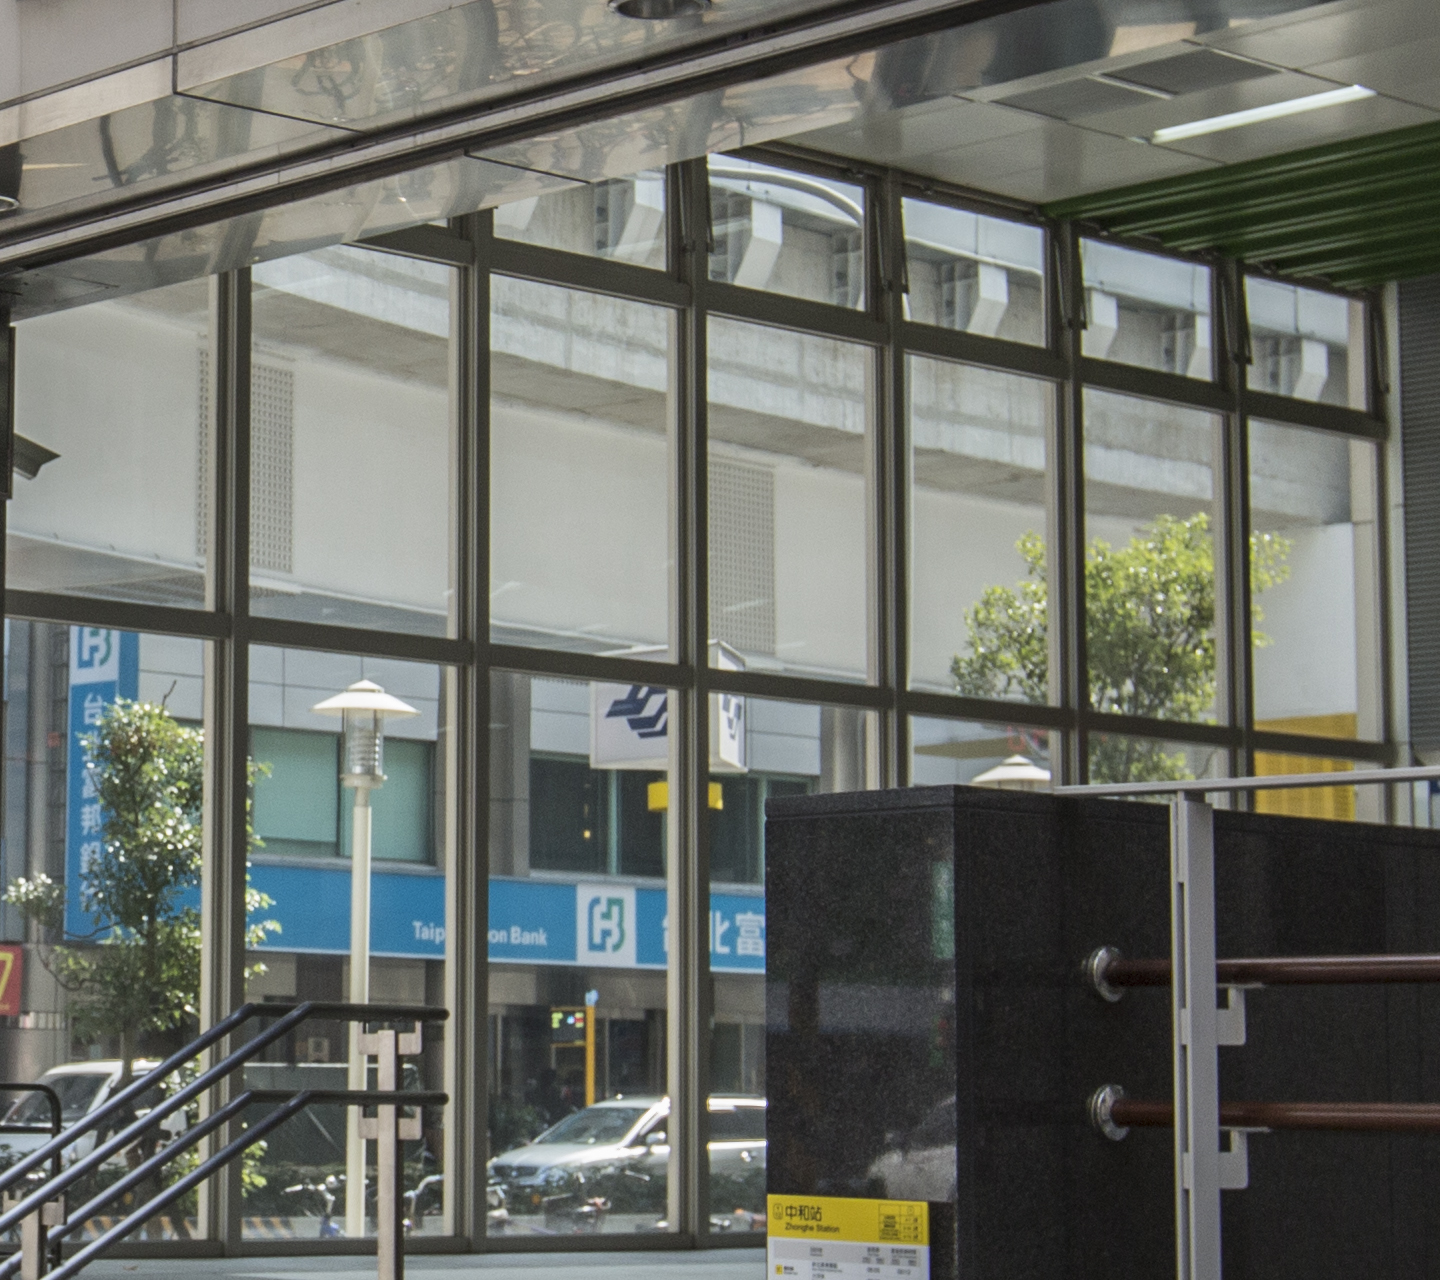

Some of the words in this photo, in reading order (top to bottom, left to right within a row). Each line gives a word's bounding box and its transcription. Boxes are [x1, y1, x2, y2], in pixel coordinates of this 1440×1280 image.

[510, 924, 547, 946] Bank
[785, 1205, 823, 1222] 中和站
[785, 1222, 815, 1233] Zhonghe
[816, 1223, 840, 1233] Station
